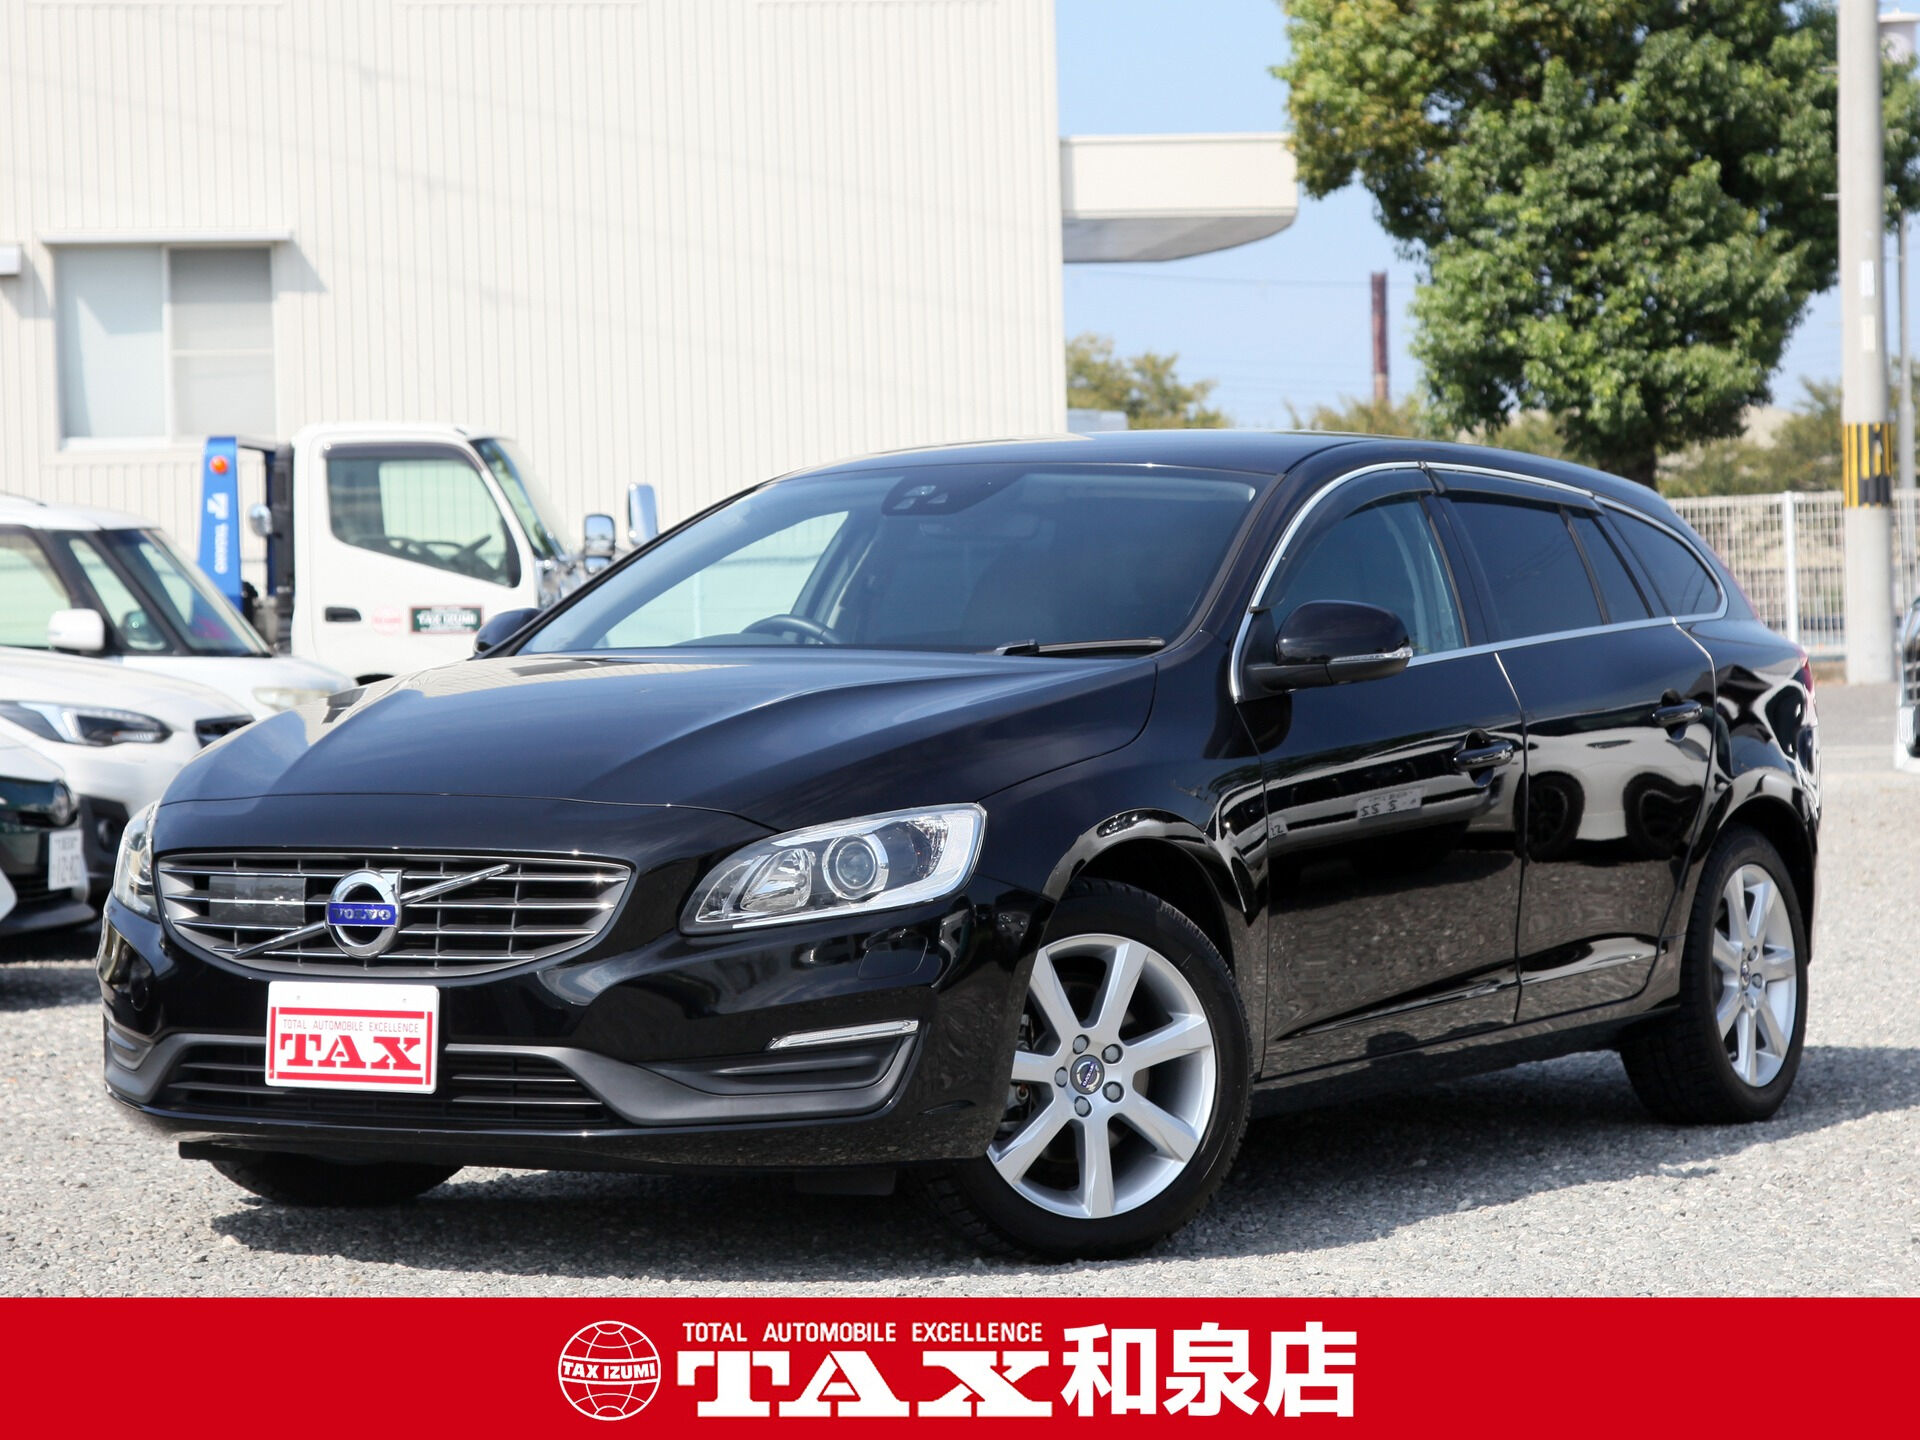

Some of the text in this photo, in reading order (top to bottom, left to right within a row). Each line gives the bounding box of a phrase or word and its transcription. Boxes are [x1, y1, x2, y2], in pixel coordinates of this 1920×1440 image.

[332, 908, 392, 920] VOLVO
[283, 1018, 419, 1033] TOTAL AUTOMOBILE EXCELLENCE
[280, 1033, 421, 1071] TAX
